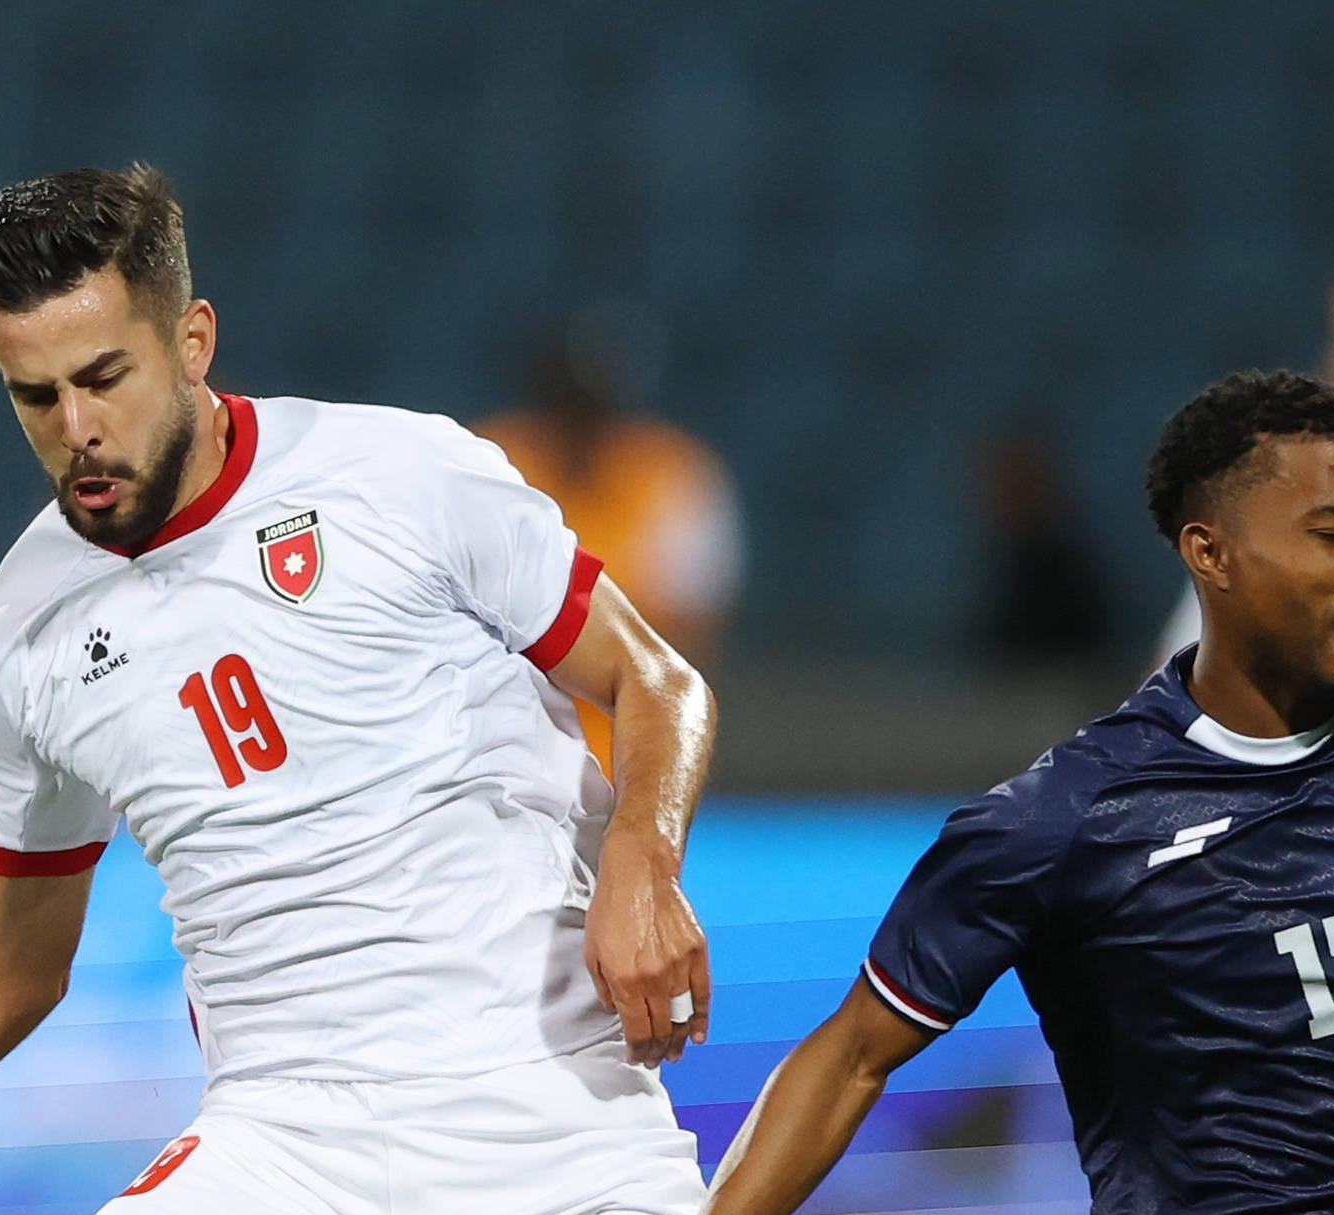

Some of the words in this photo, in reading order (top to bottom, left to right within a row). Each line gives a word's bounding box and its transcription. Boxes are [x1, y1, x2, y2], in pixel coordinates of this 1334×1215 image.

[264, 514, 312, 541] JORDAN
[81, 652, 129, 685] KELME
[178, 653, 288, 788] 19
